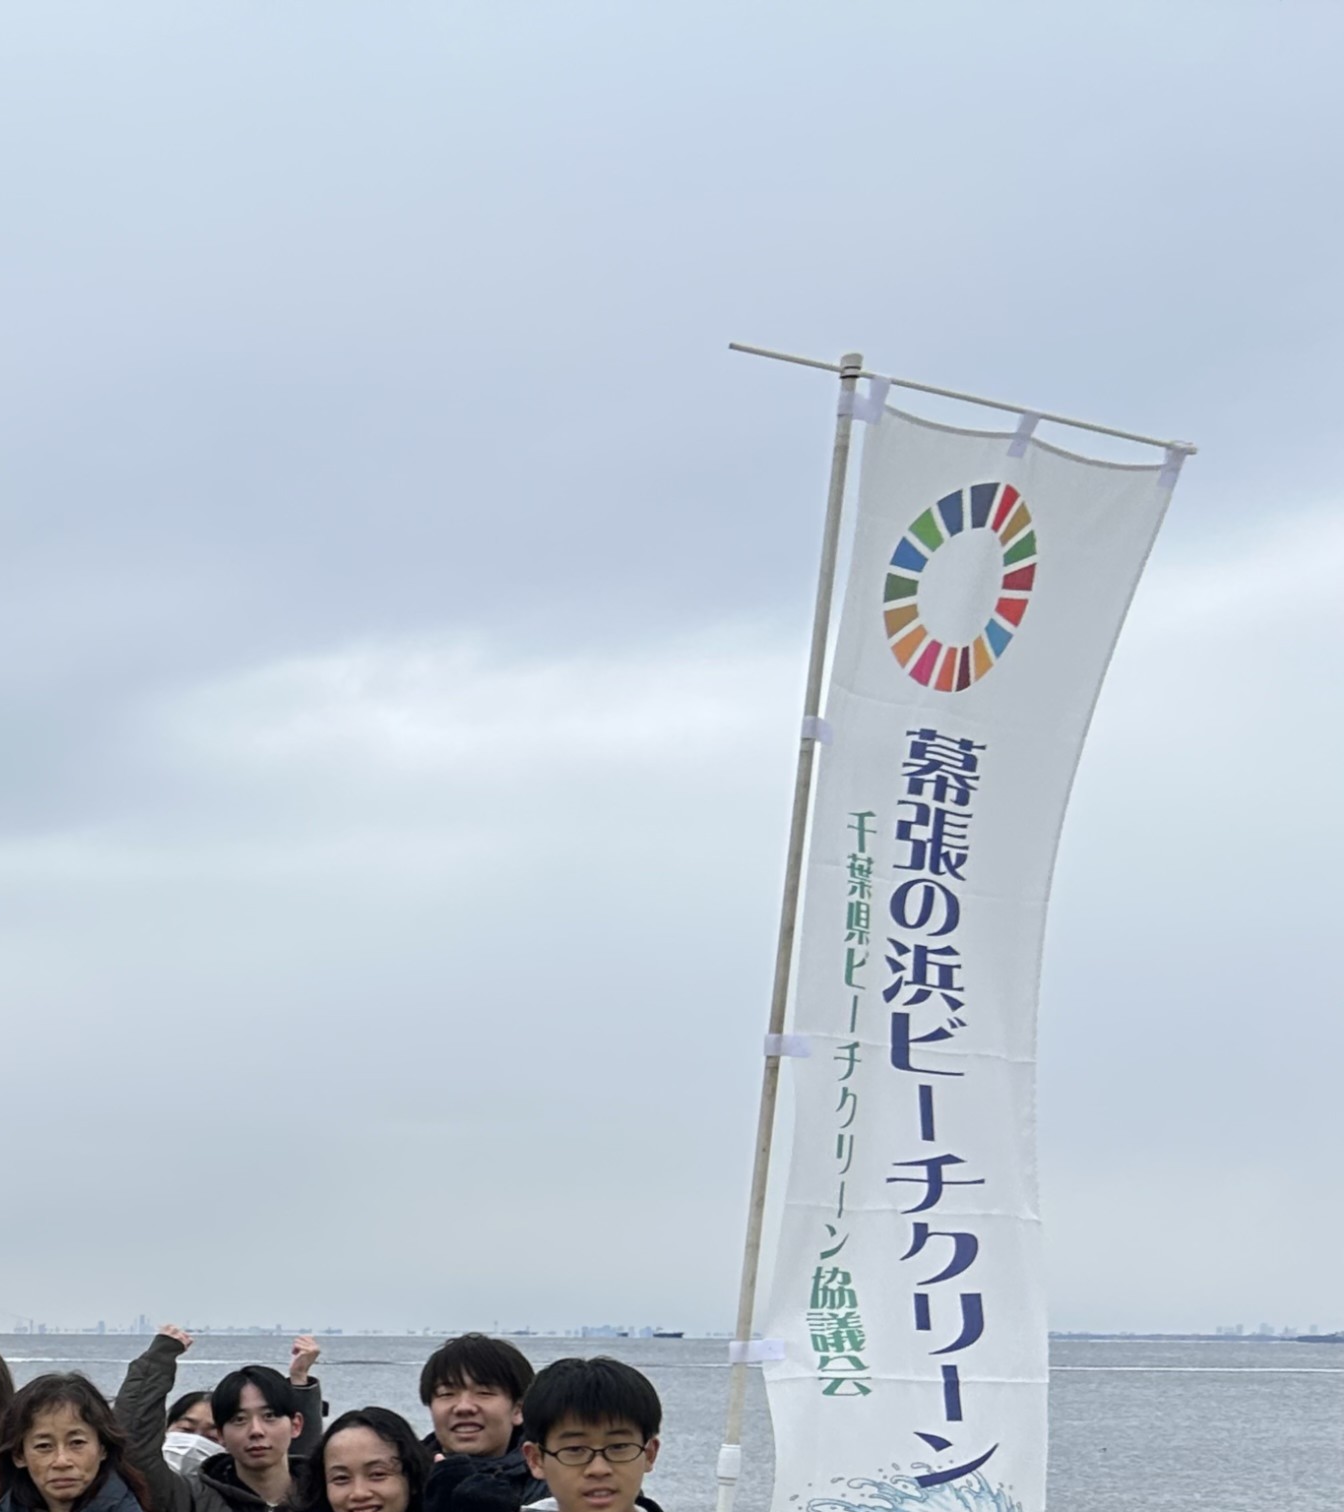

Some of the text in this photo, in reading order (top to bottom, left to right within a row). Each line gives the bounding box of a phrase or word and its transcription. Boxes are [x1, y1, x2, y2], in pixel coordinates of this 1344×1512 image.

[807, 811, 877, 1397] 千葉県ビーチクリーン協議会
[882, 728, 999, 1488] 幕張の浜ビーチクリーン
